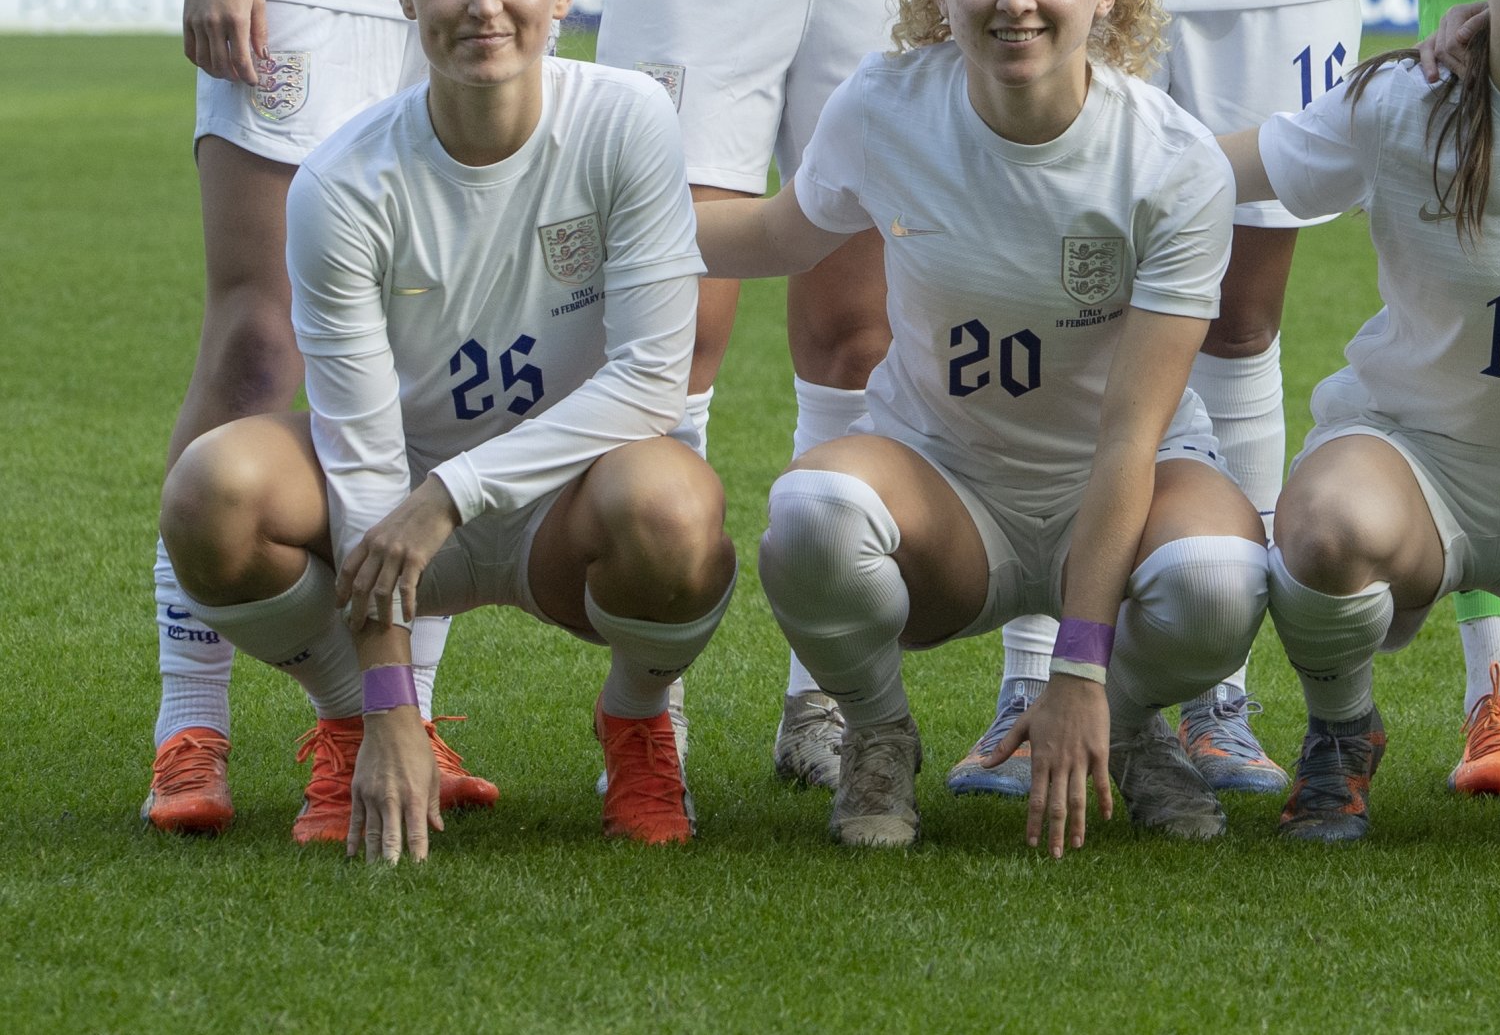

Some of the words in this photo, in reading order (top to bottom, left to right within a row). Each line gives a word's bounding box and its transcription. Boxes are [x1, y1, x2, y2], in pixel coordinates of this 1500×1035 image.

[571, 285, 594, 301] ITALY
[551, 308, 560, 317] 19
[560, 293, 600, 314] FEBRUARY
[1080, 308, 1102, 318] ITALY
[1056, 319, 1064, 328] 19
[1065, 314, 1108, 328] FEBRUARY
[950, 319, 1041, 397] 20
[450, 335, 544, 420] 25
